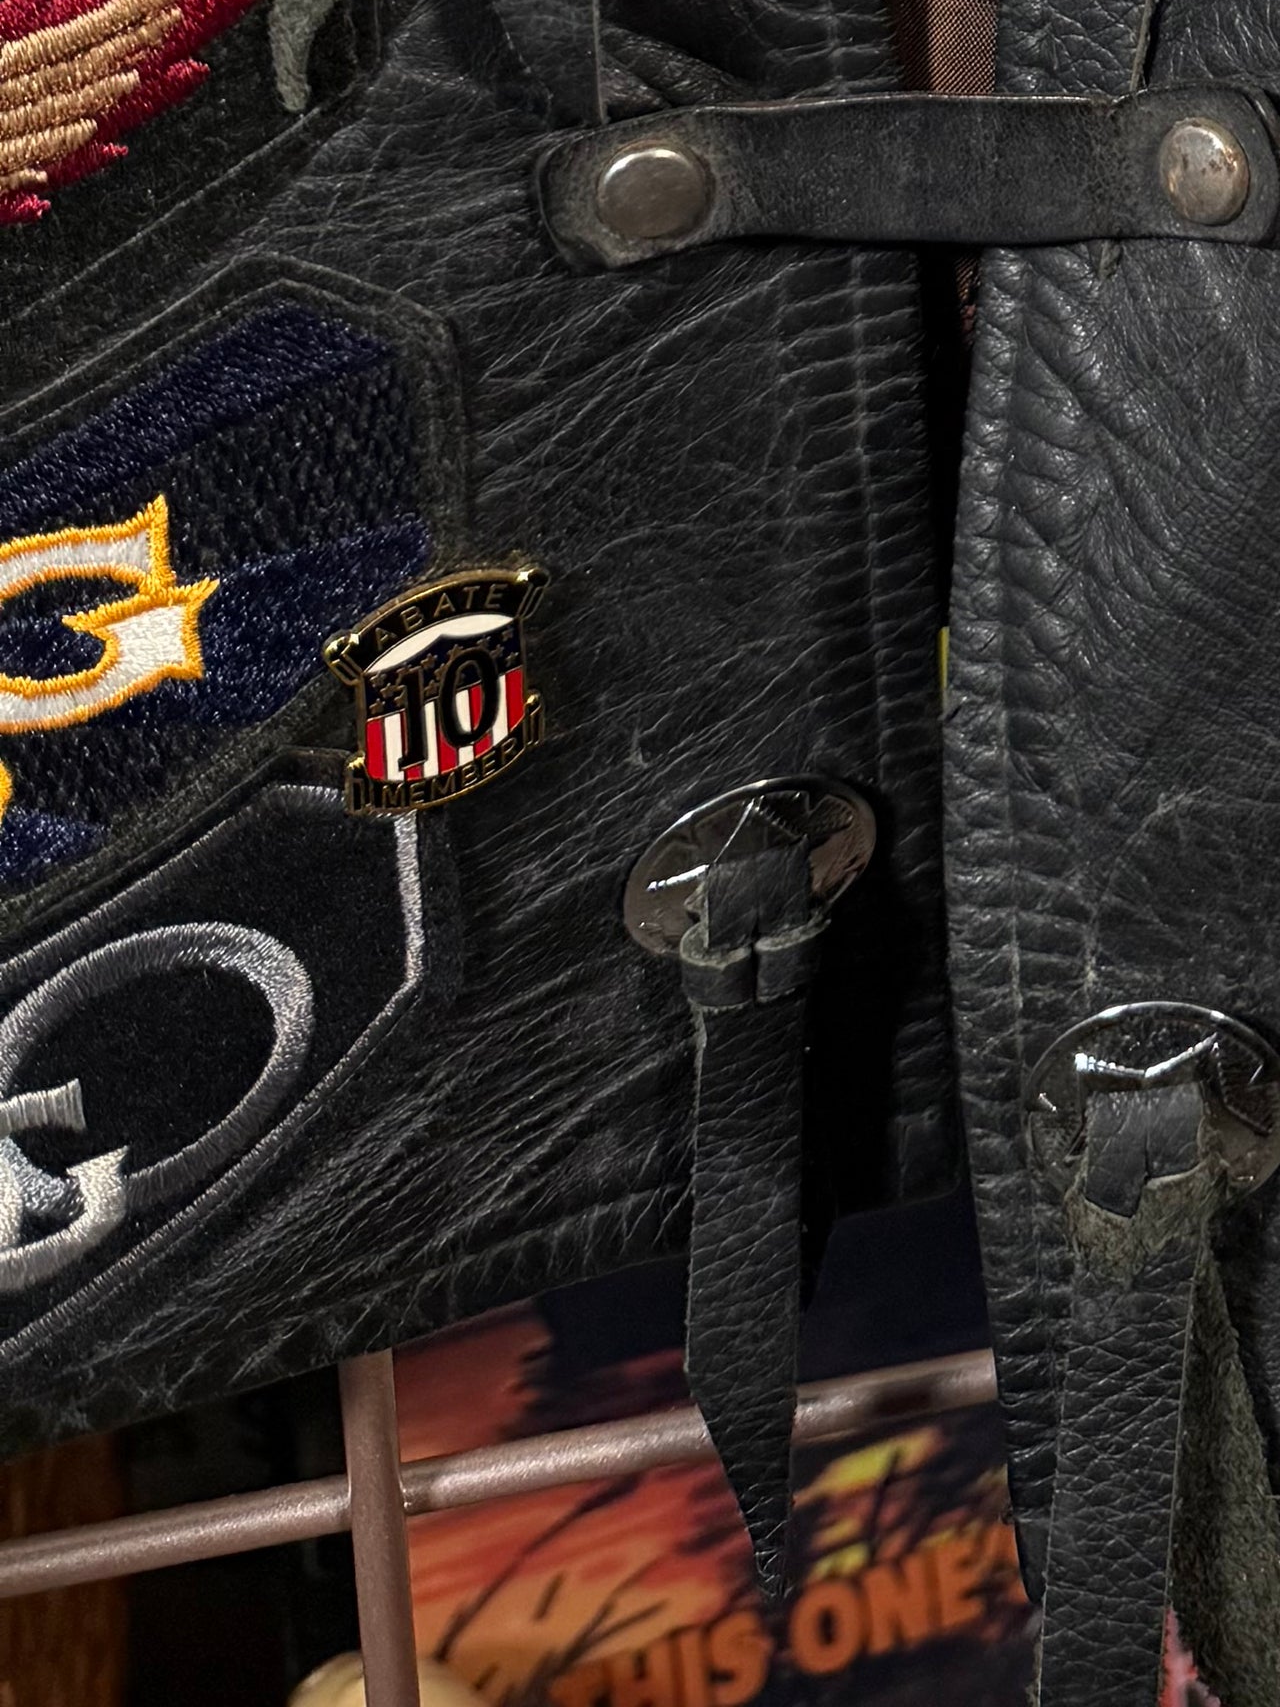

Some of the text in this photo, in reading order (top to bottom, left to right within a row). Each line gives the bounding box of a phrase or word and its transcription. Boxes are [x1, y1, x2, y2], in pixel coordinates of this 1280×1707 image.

[374, 583, 506, 651] ABATE
[396, 646, 501, 772] 10
[382, 737, 519, 808] MEMBER
[789, 1539, 985, 1675] ONE
